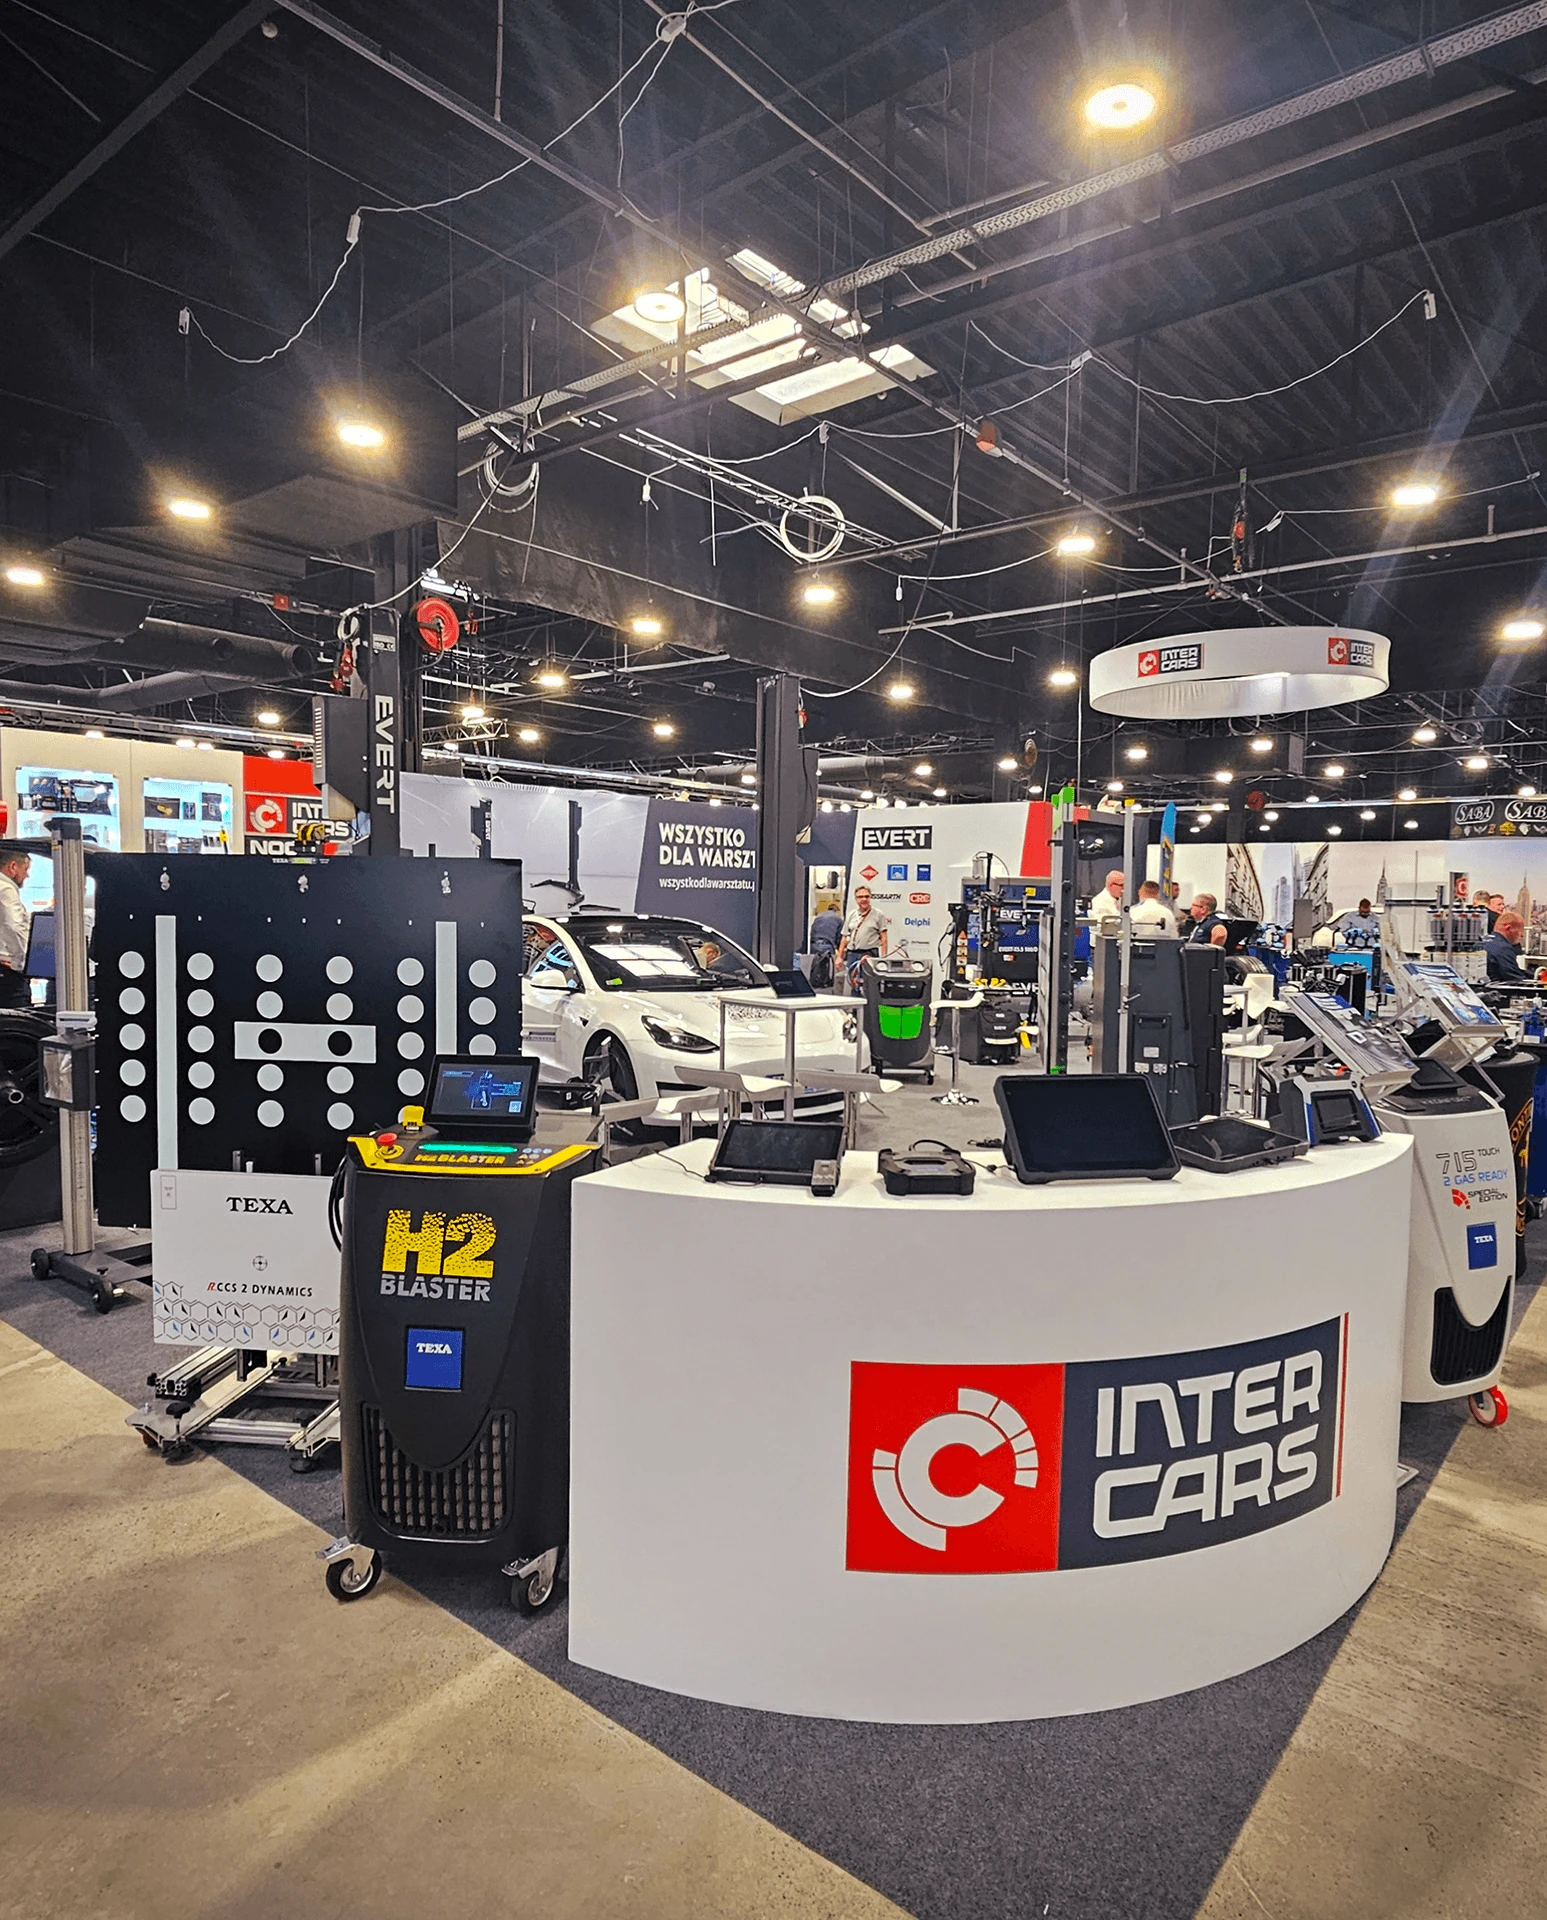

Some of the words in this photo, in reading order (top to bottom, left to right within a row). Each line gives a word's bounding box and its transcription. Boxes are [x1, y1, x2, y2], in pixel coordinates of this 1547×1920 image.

[1161, 647, 1198, 661] INTER
[1351, 642, 1373, 655] INTER
[1161, 657, 1198, 671] CARS
[1351, 653, 1373, 666] CARS
[375, 694, 395, 814] EVERT
[292, 802, 323, 819] INT
[1457, 804, 1491, 822] SABA
[1508, 802, 1547, 819] SAB
[659, 822, 746, 848] WSZYSTKO
[863, 828, 930, 847] EVERT
[659, 845, 694, 866] DLA
[905, 917, 930, 927] Delphi
[437, 1154, 506, 1165] BLASTER
[1436, 1150, 1477, 1174] 715
[1477, 1147, 1500, 1156] TOUCH
[1443, 1176, 1451, 1186] 2
[1454, 1173, 1475, 1185] GAS
[1478, 1169, 1508, 1181] READY
[1467, 1188, 1498, 1198] SPECIAL
[1479, 1193, 1508, 1203] EDITION
[226, 1197, 293, 1214] TEXA
[382, 1209, 497, 1278] H2
[241, 1283, 248, 1293] 2
[252, 1285, 313, 1297] DYNAMICS
[380, 1274, 491, 1301] BLASTER
[416, 1342, 453, 1354] TEXA
[1096, 1349, 1323, 1458] INTER
[1093, 1423, 1319, 1539] CARS
